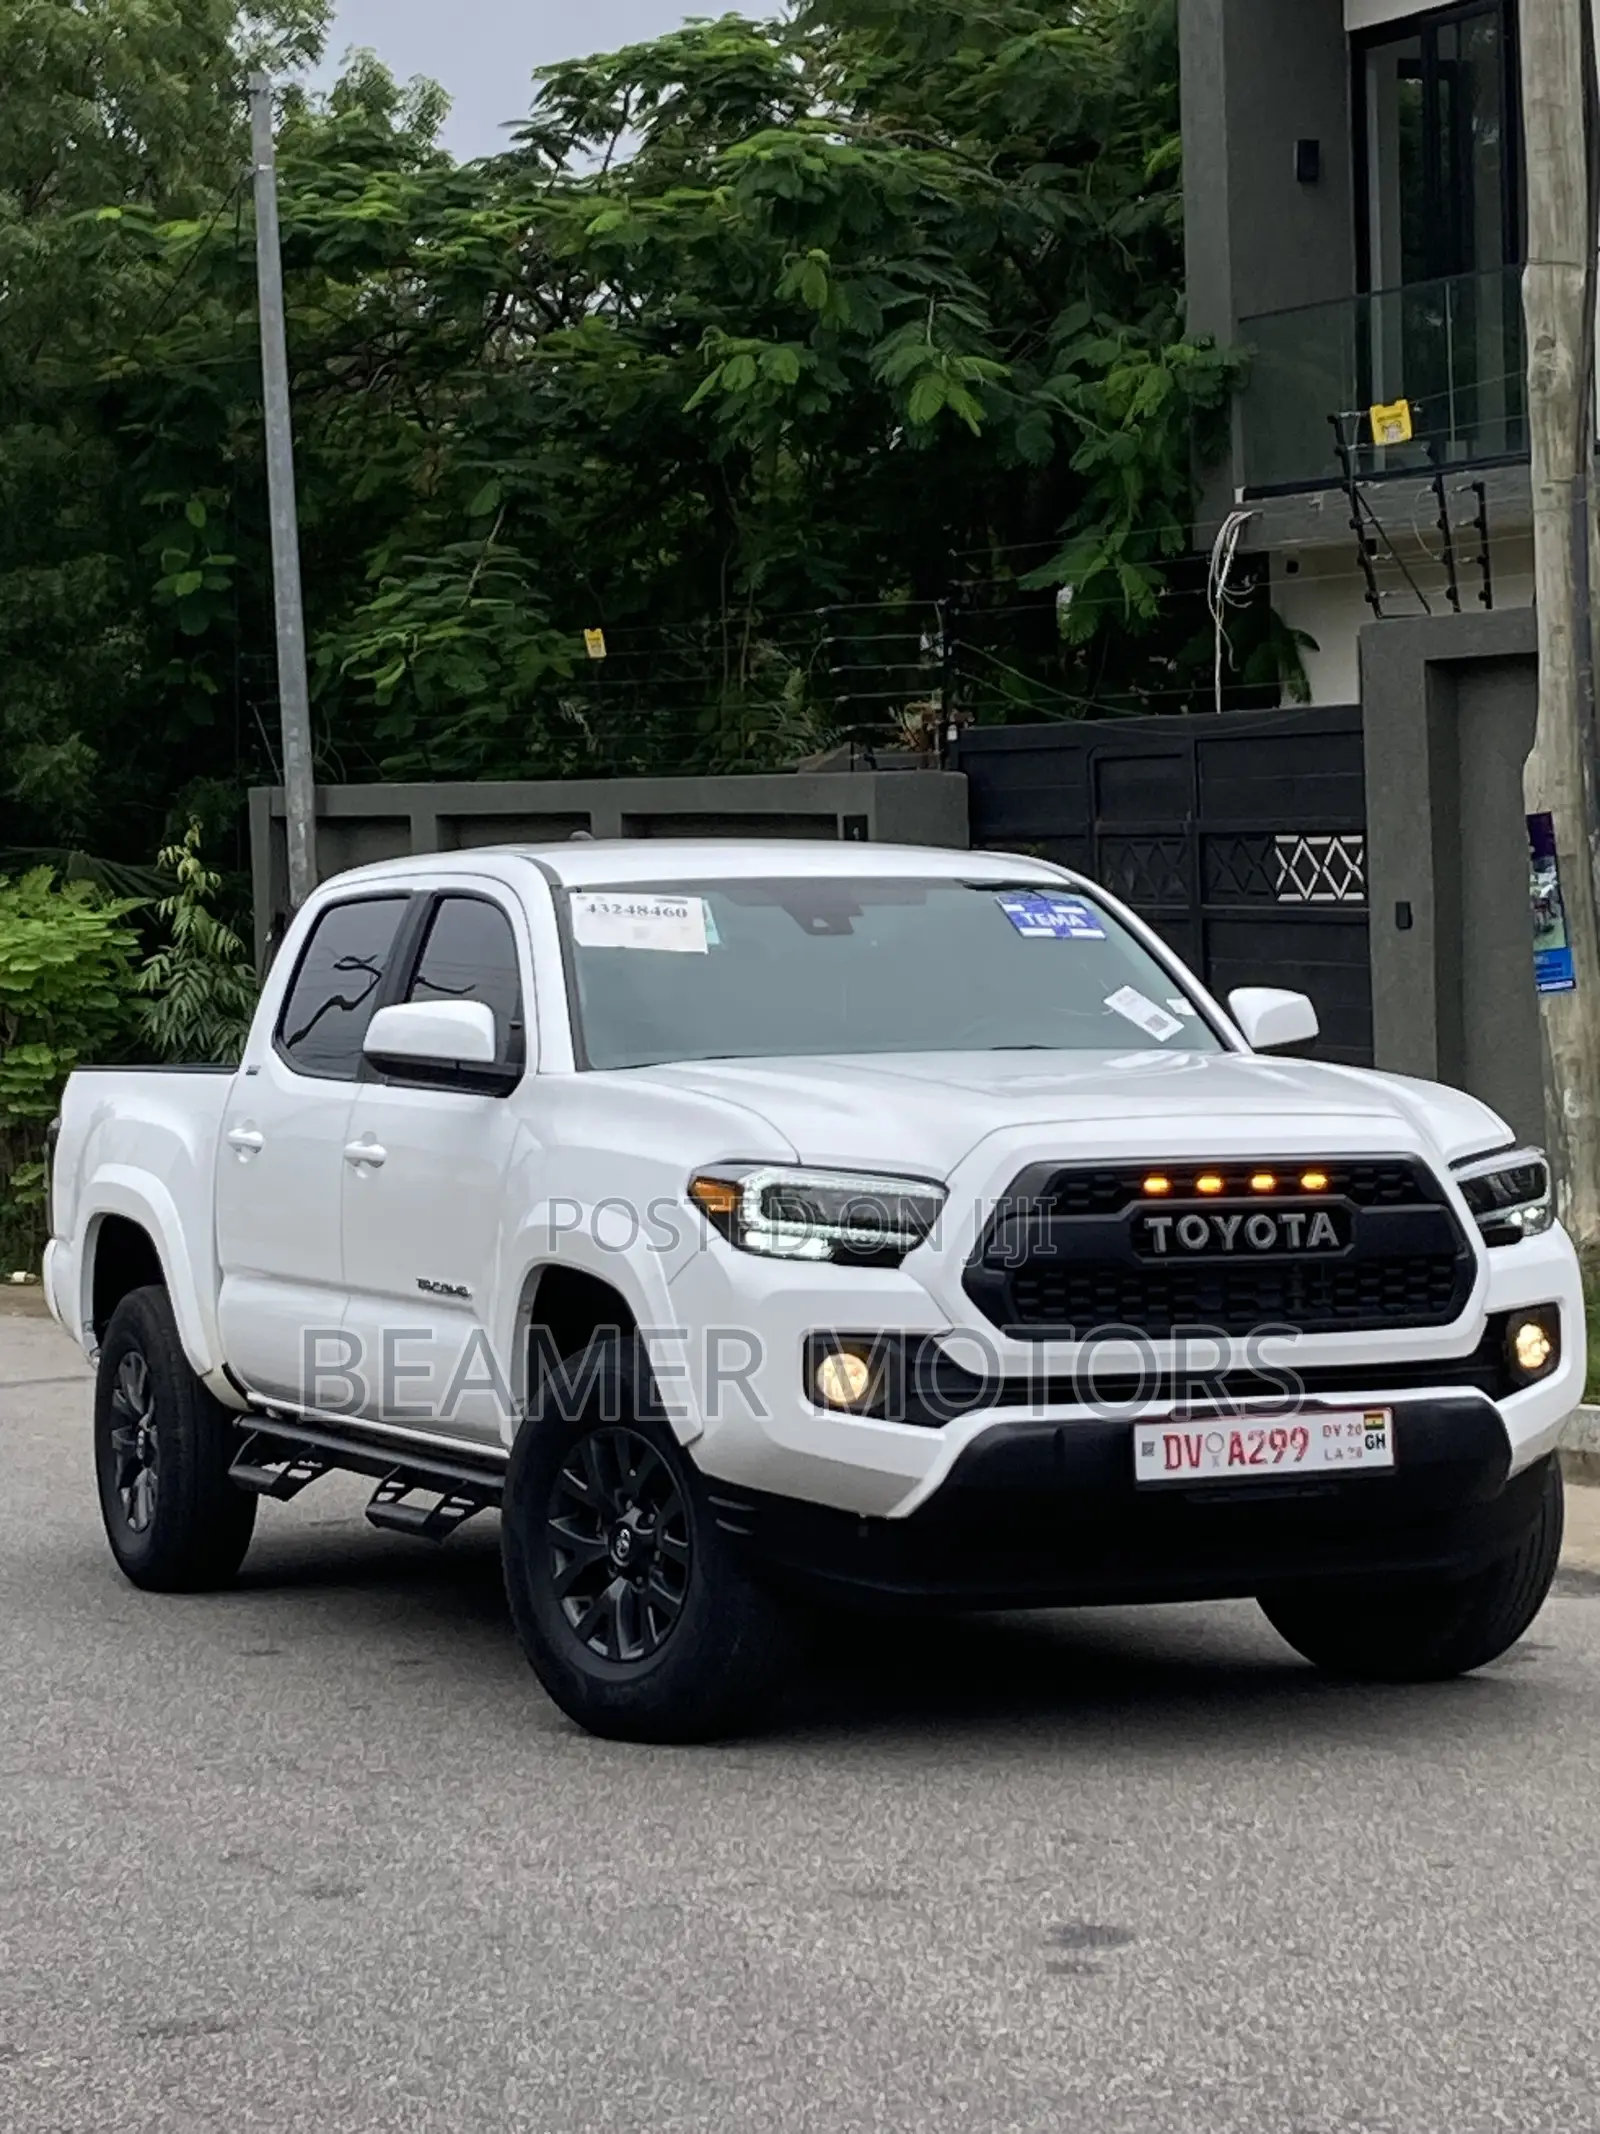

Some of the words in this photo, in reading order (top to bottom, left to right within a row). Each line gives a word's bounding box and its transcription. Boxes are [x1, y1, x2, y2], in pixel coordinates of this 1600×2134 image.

[1020, 911, 1088, 928] TEMA
[1144, 1211, 1341, 1253] TOYOTA
[1162, 1433, 1203, 1470] DV
[1227, 1426, 1309, 1467] A299
[1364, 1432, 1387, 1450] GH
